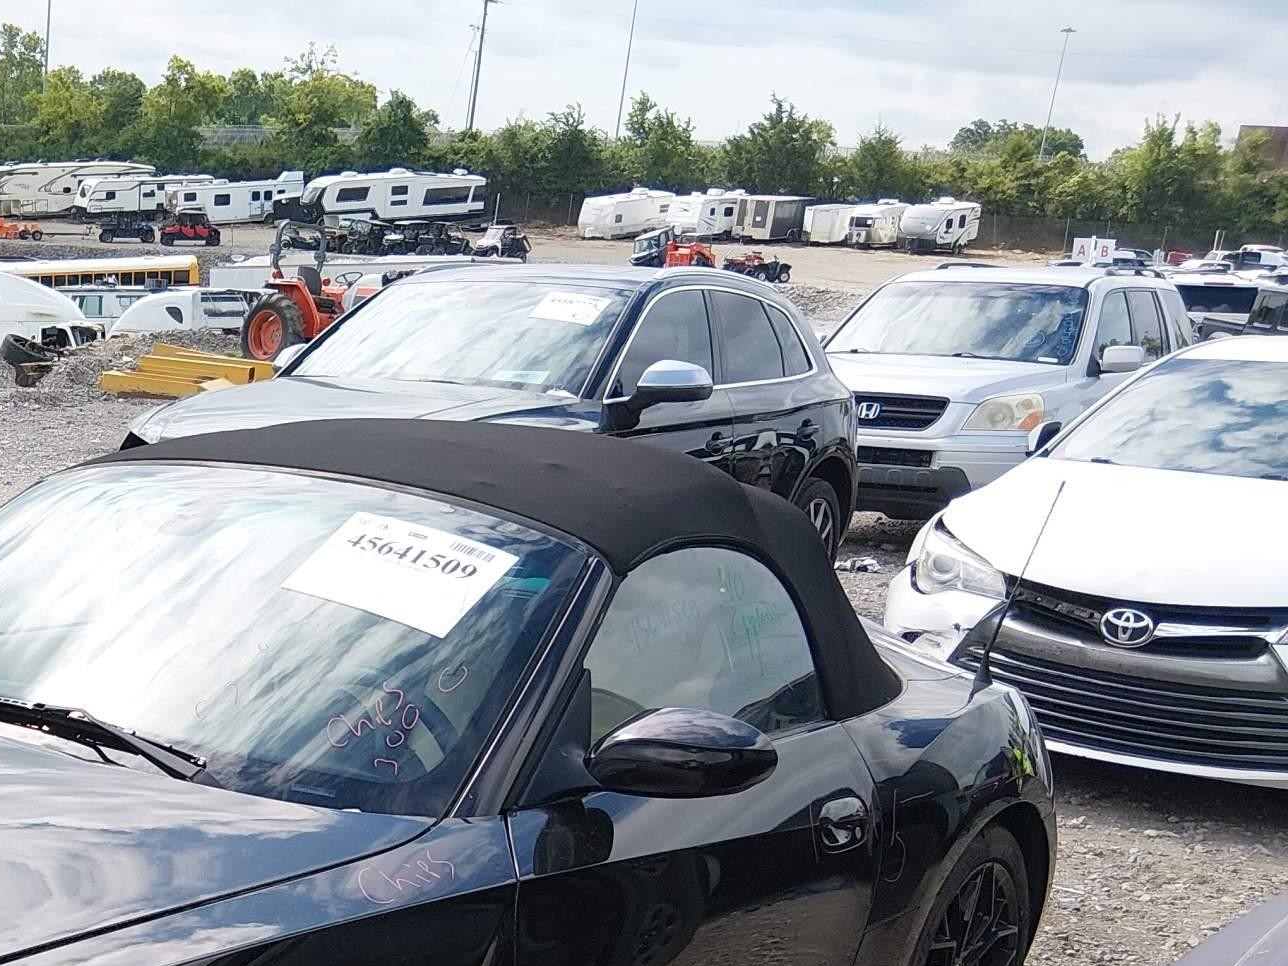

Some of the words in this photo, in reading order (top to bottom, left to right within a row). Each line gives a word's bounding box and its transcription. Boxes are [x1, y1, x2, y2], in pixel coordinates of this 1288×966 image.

[1077, 245, 1085, 256] A
[1101, 246, 1109, 257] B
[347, 533, 478, 579] 45641509
